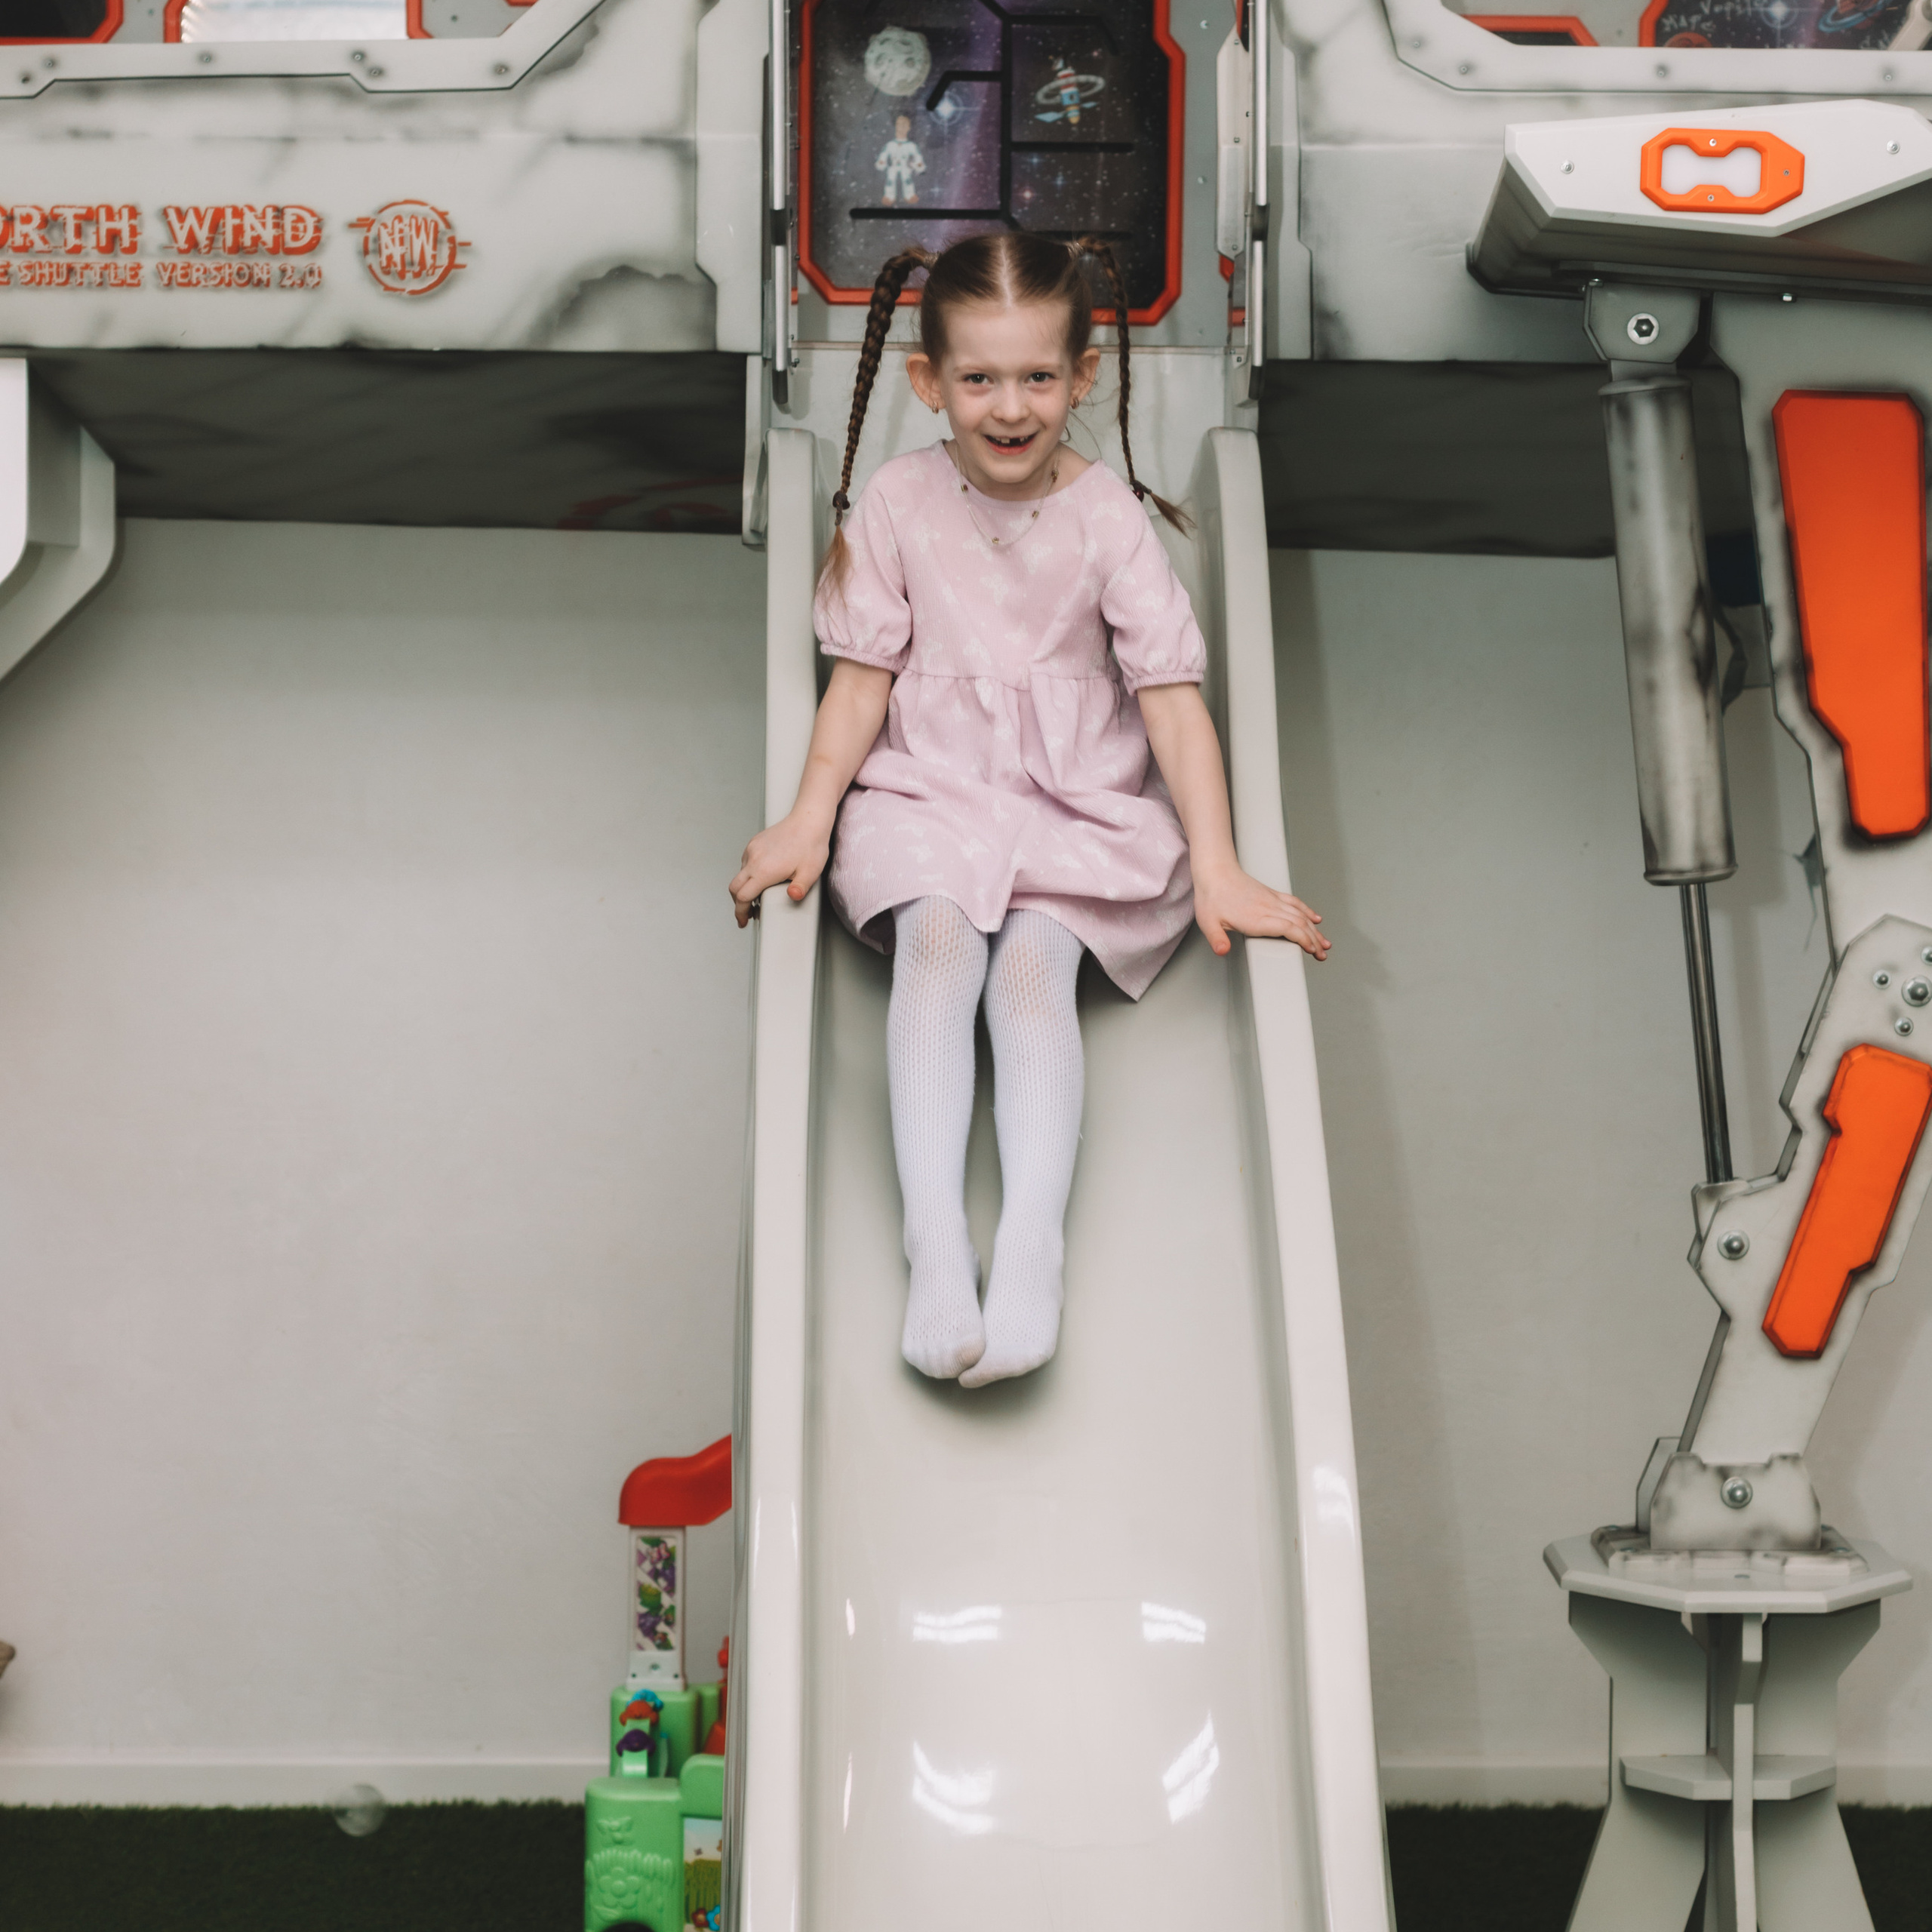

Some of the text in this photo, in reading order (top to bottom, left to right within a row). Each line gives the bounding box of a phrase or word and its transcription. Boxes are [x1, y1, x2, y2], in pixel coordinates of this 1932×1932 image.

[0, 204, 322, 255] RTH WIND
[18, 260, 143, 288] SHUTTLE
[155, 261, 271, 288] VERSION
[278, 263, 322, 288] 2.0
